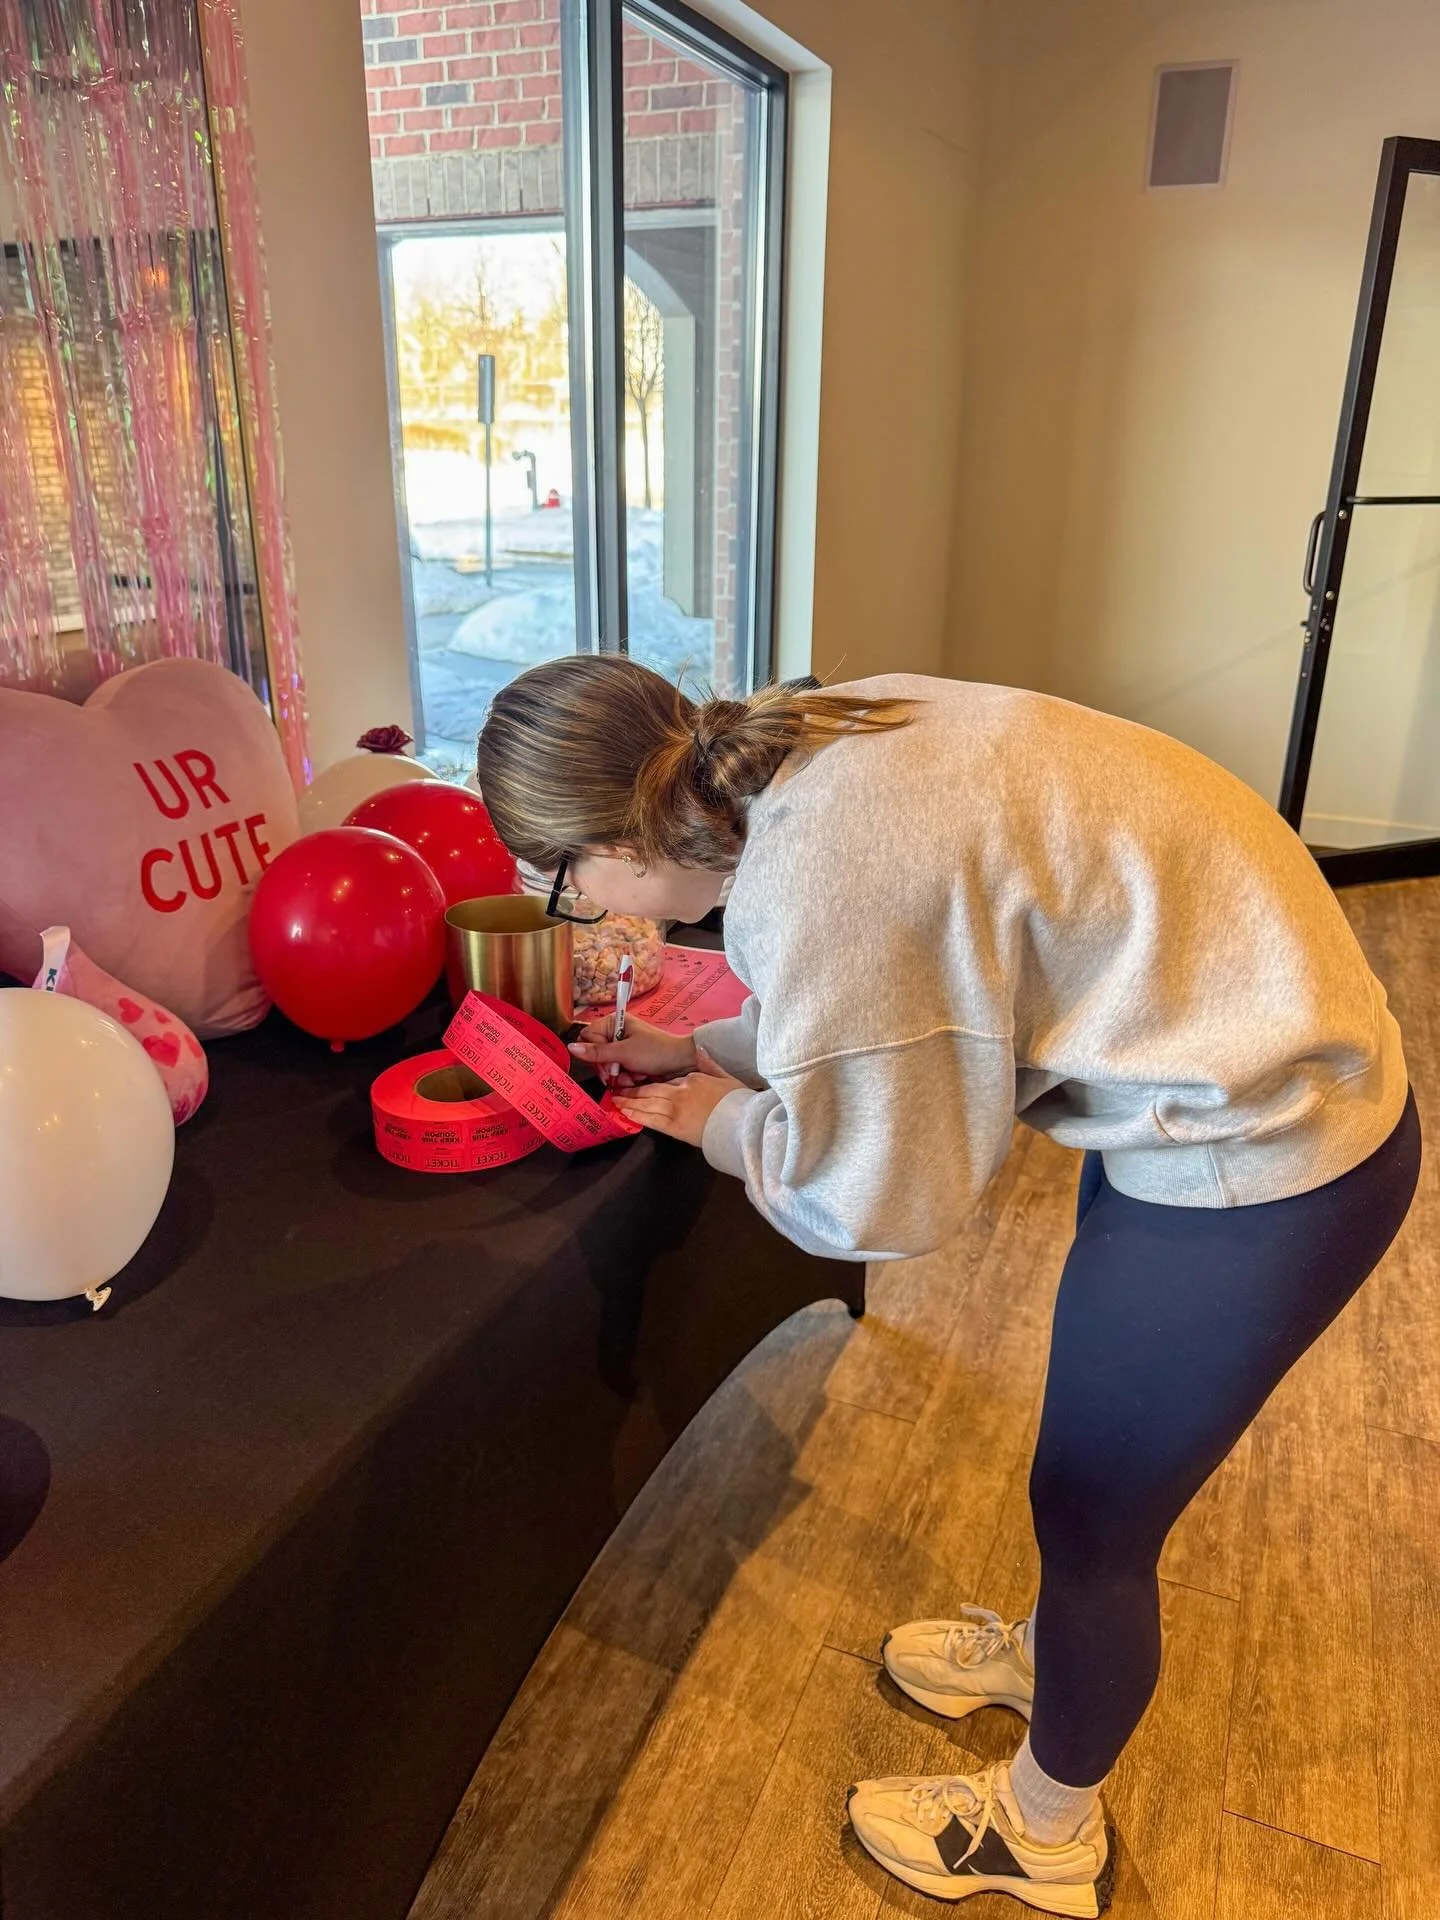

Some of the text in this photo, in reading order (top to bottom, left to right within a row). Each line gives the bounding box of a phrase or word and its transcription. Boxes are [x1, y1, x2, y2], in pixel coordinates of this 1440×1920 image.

[133, 749, 230, 820] UR
[140, 813, 275, 913] CUTE
[459, 1043, 480, 1063] TICKET
[510, 1044, 535, 1067] COUPON
[486, 1066, 514, 1093] TICKET
[545, 1076, 573, 1101] COUPON
[521, 1098, 551, 1127] TICKET
